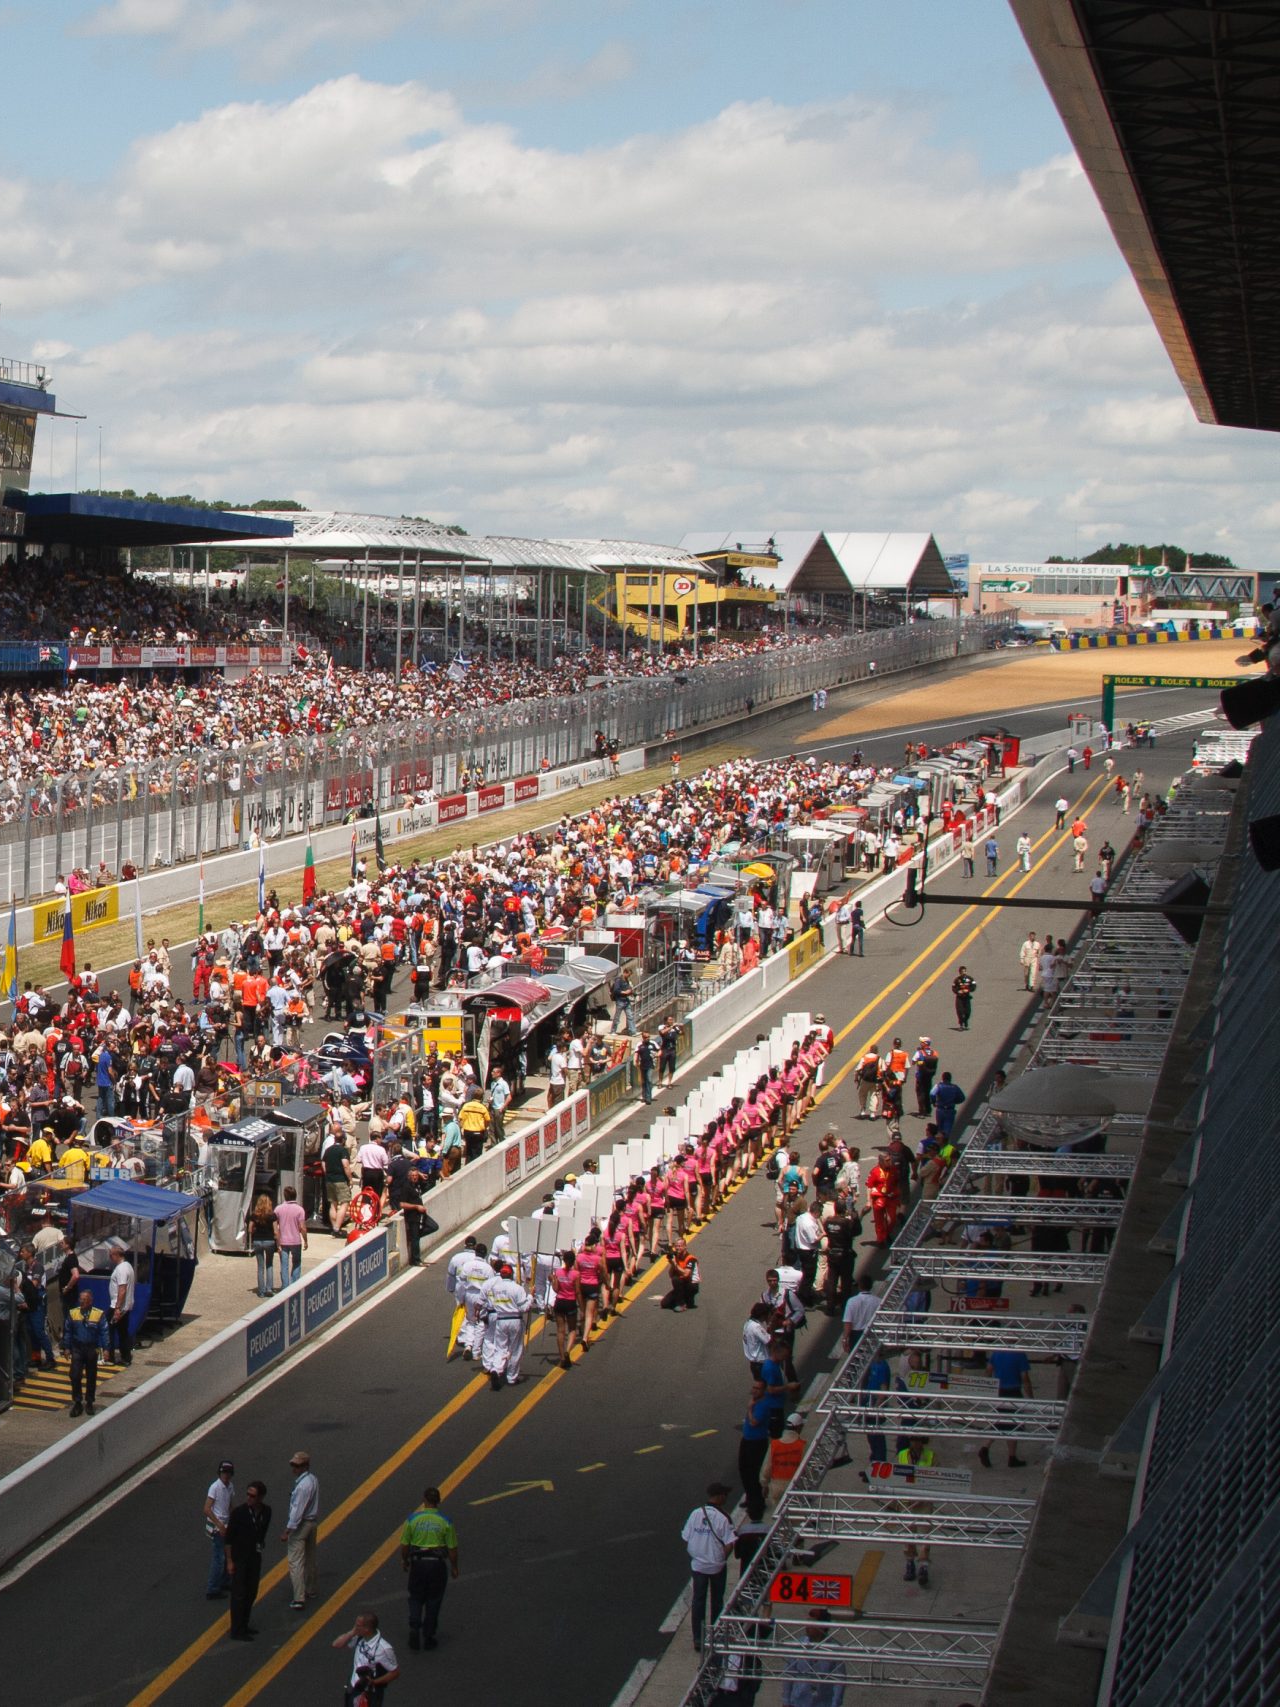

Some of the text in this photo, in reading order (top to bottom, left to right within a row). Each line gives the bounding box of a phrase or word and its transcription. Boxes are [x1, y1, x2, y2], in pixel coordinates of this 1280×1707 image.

[1005, 565, 1045, 574] SARTHE,
[85, 901, 108, 922] Nikon
[259, 1084, 276, 1096] 92
[358, 1247, 384, 1280] PEUGEOT
[308, 1280, 336, 1316] PEUGEOT
[952, 1298, 966, 1312] 76
[250, 1320, 281, 1358] PEUGEOT
[908, 1372, 928, 1388] 11
[870, 1462, 892, 1478] 10
[779, 1576, 808, 1602] 84
